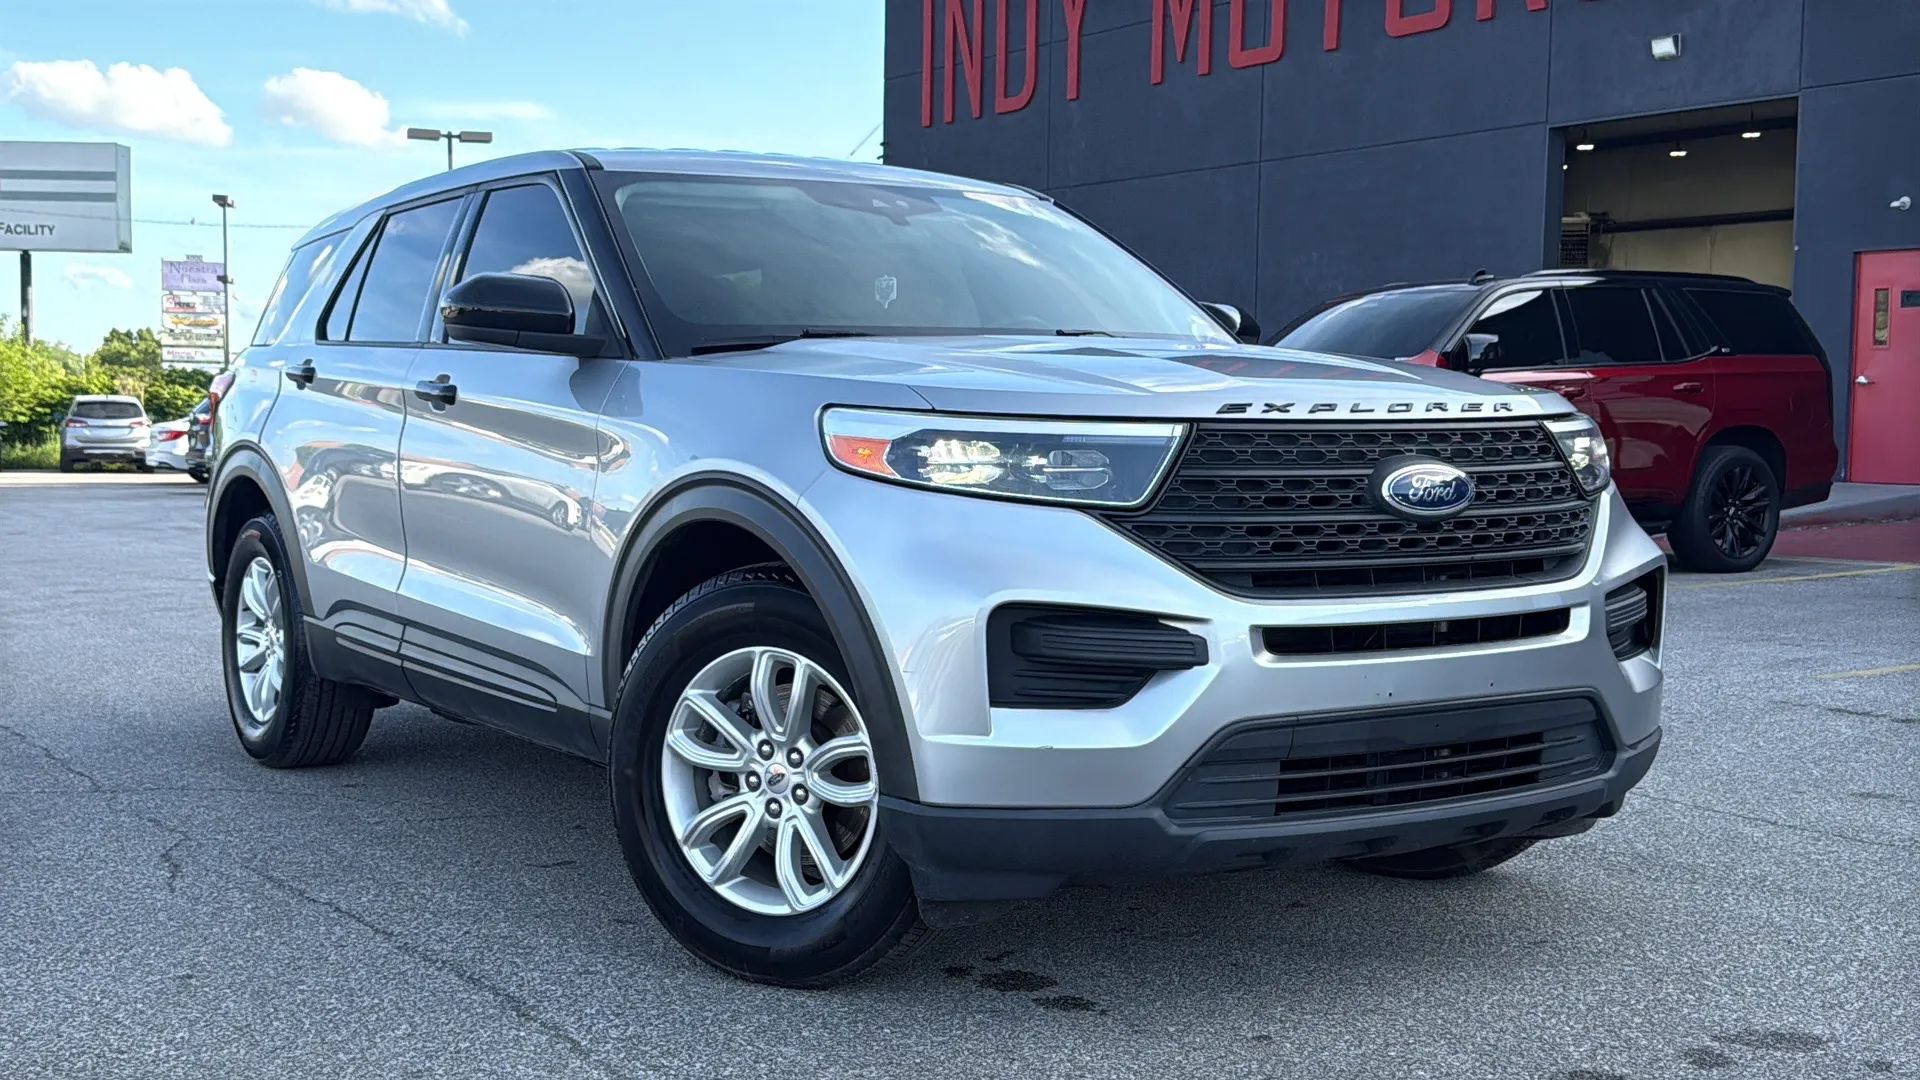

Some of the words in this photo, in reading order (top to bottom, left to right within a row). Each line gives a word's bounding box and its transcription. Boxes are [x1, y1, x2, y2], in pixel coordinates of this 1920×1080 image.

[921, 0, 1084, 128] INDY
[1216, 402, 1514, 414] EXPLORER
[1409, 475, 1457, 502] Ford
